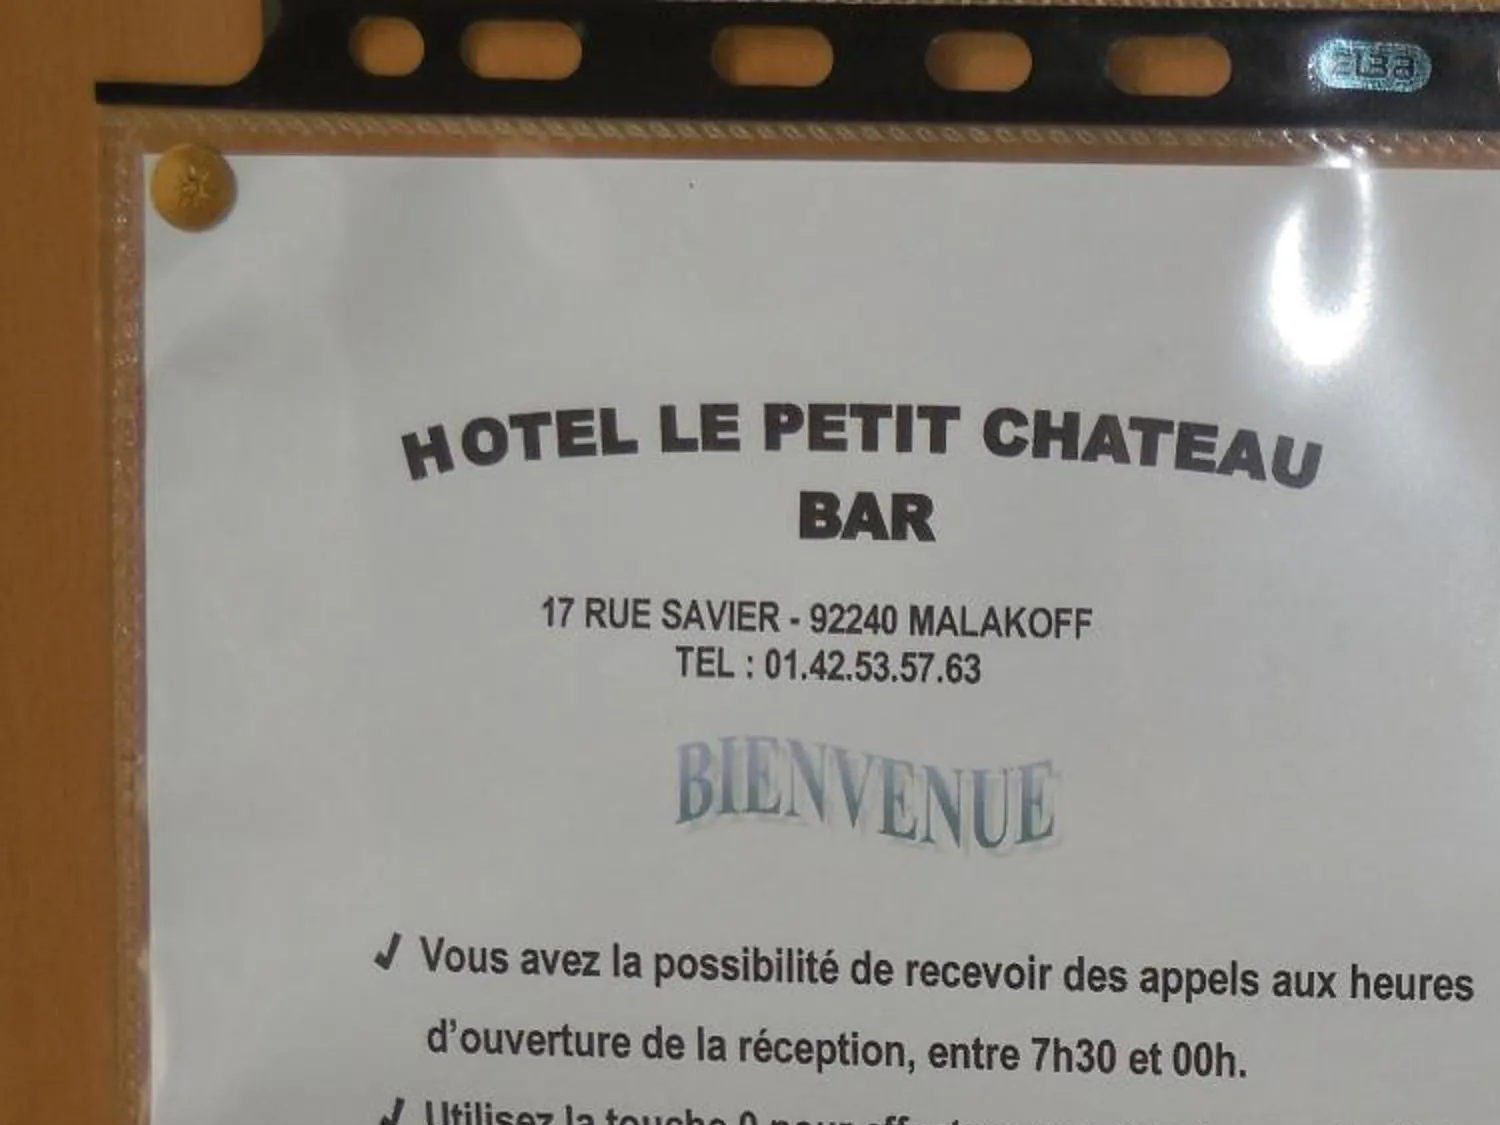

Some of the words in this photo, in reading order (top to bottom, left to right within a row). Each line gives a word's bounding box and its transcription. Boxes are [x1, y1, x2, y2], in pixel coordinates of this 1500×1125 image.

[401, 407, 638, 481] HOTEL
[659, 403, 741, 454] LE
[763, 402, 961, 454] PETIT
[983, 407, 1323, 489] CHATEAU
[799, 490, 936, 542] BAR
[542, 596, 575, 628] 17
[585, 597, 651, 630] RUE
[662, 598, 780, 632] SAVIER
[810, 603, 898, 635] 92240
[910, 604, 1093, 640] MALAKOFF
[675, 645, 735, 678] TEL
[765, 648, 981, 684] 01.42.53.57.63
[675, 734, 1056, 850] BIENVENUE
[419, 936, 509, 974] Vous
[520, 948, 600, 976] avez
[613, 942, 642, 978] la
[654, 946, 840, 988] possibilité
[851, 950, 894, 986] de
[906, 954, 1053, 991] recevoir
[1064, 956, 1128, 993] des
[1139, 960, 1259, 1004] appels
[1272, 970, 1337, 998] aux
[1350, 963, 1474, 1002] heures
[642, 1025, 685, 1060] de
[697, 1026, 727, 1062] la
[739, 1028, 915, 1075] réception,
[928, 1036, 1020, 1071] entre
[1031, 1037, 1116, 1074] 7h30
[1129, 1042, 1162, 1076] et
[1172, 1041, 1246, 1078] 00h.
